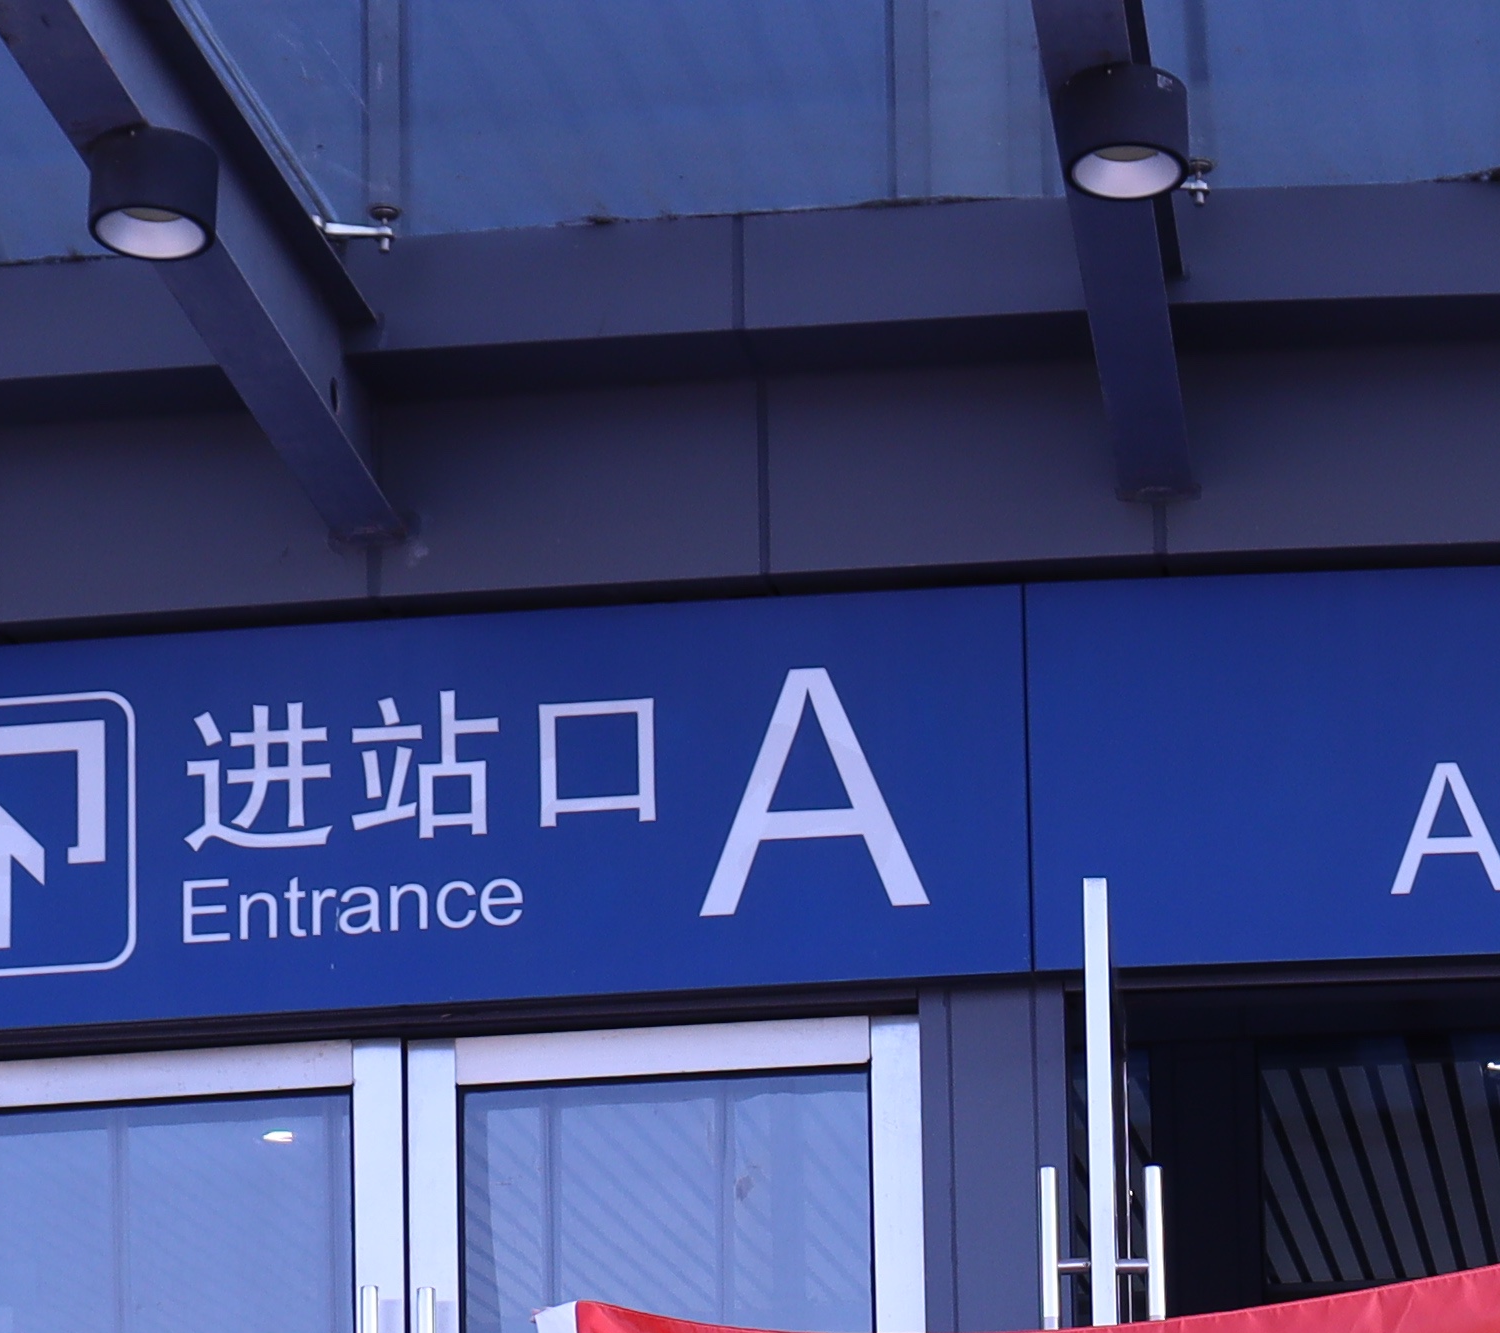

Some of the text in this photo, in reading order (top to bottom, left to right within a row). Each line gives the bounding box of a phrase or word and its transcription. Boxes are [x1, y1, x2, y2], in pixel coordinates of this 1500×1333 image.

[184, 667, 930, 918] 进站口 A
[182, 877, 525, 945] Entrance
